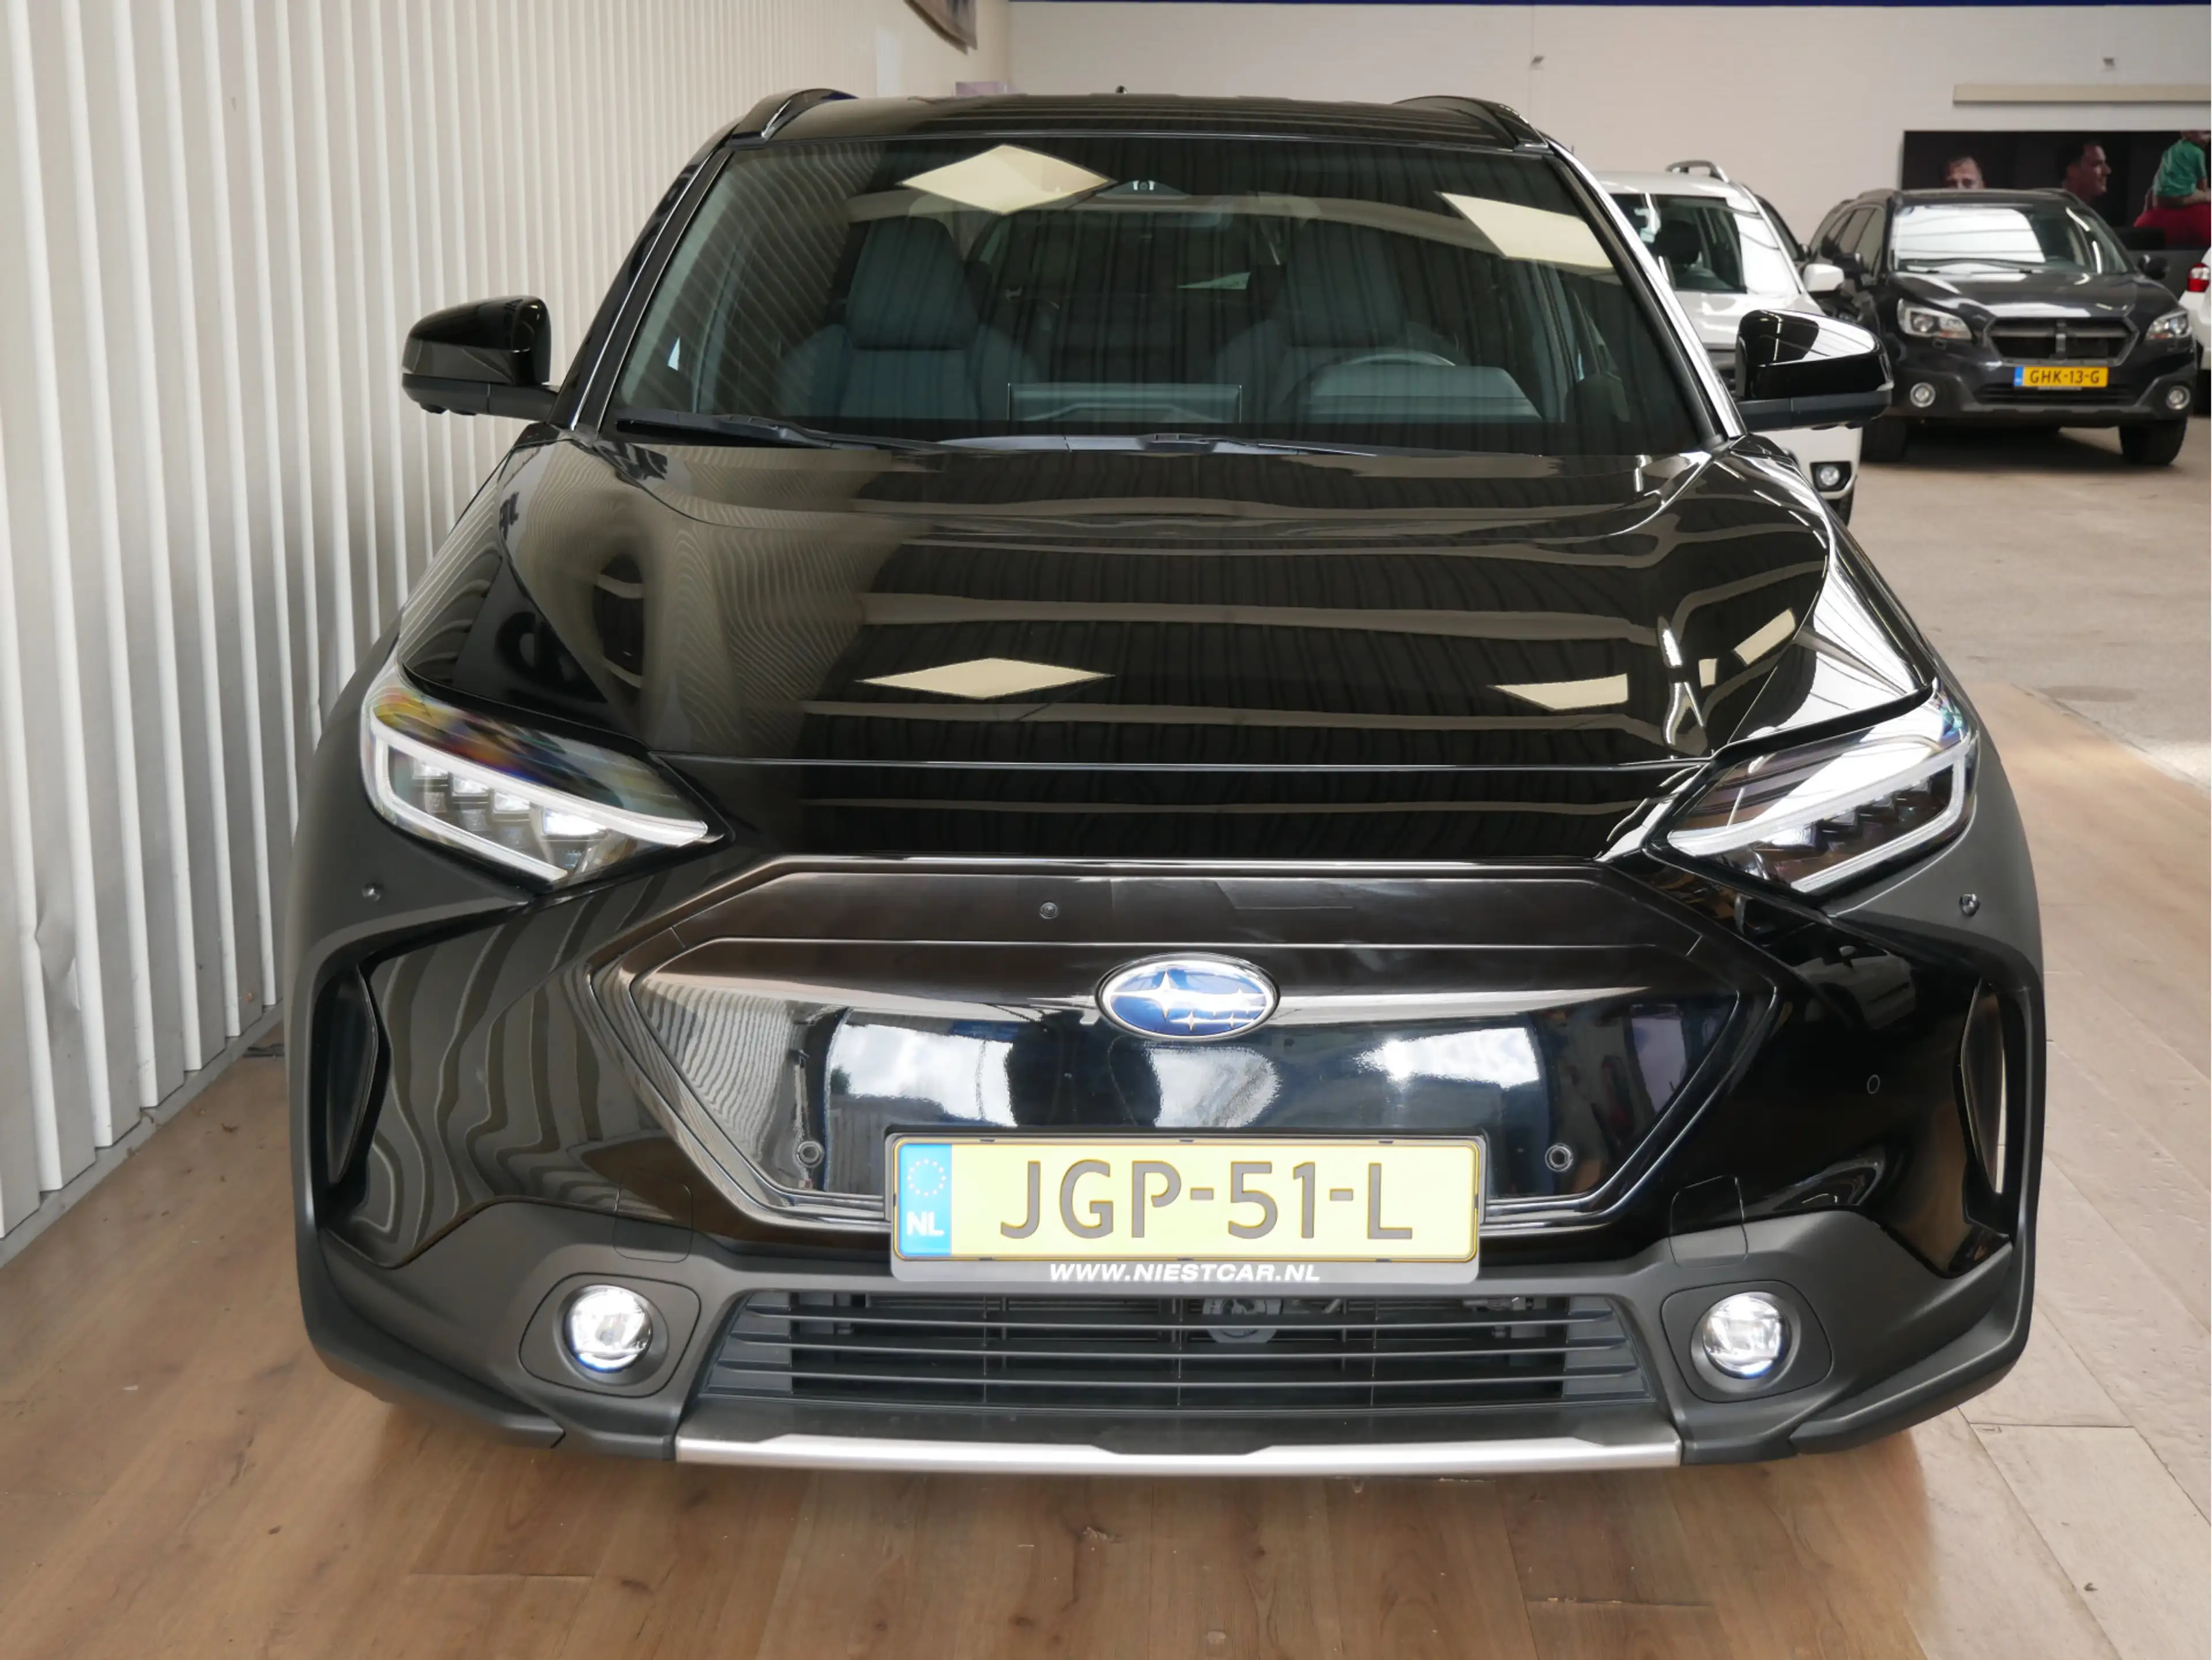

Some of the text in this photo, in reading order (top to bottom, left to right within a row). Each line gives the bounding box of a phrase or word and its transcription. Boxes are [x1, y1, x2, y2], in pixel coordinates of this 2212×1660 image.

[2029, 369, 2100, 384] GHK-13-G
[999, 1159, 1413, 1240] JGP-51-L
[906, 1211, 944, 1236] NL
[1050, 1263, 1321, 1283] WWW.NIESTCAR.NL
